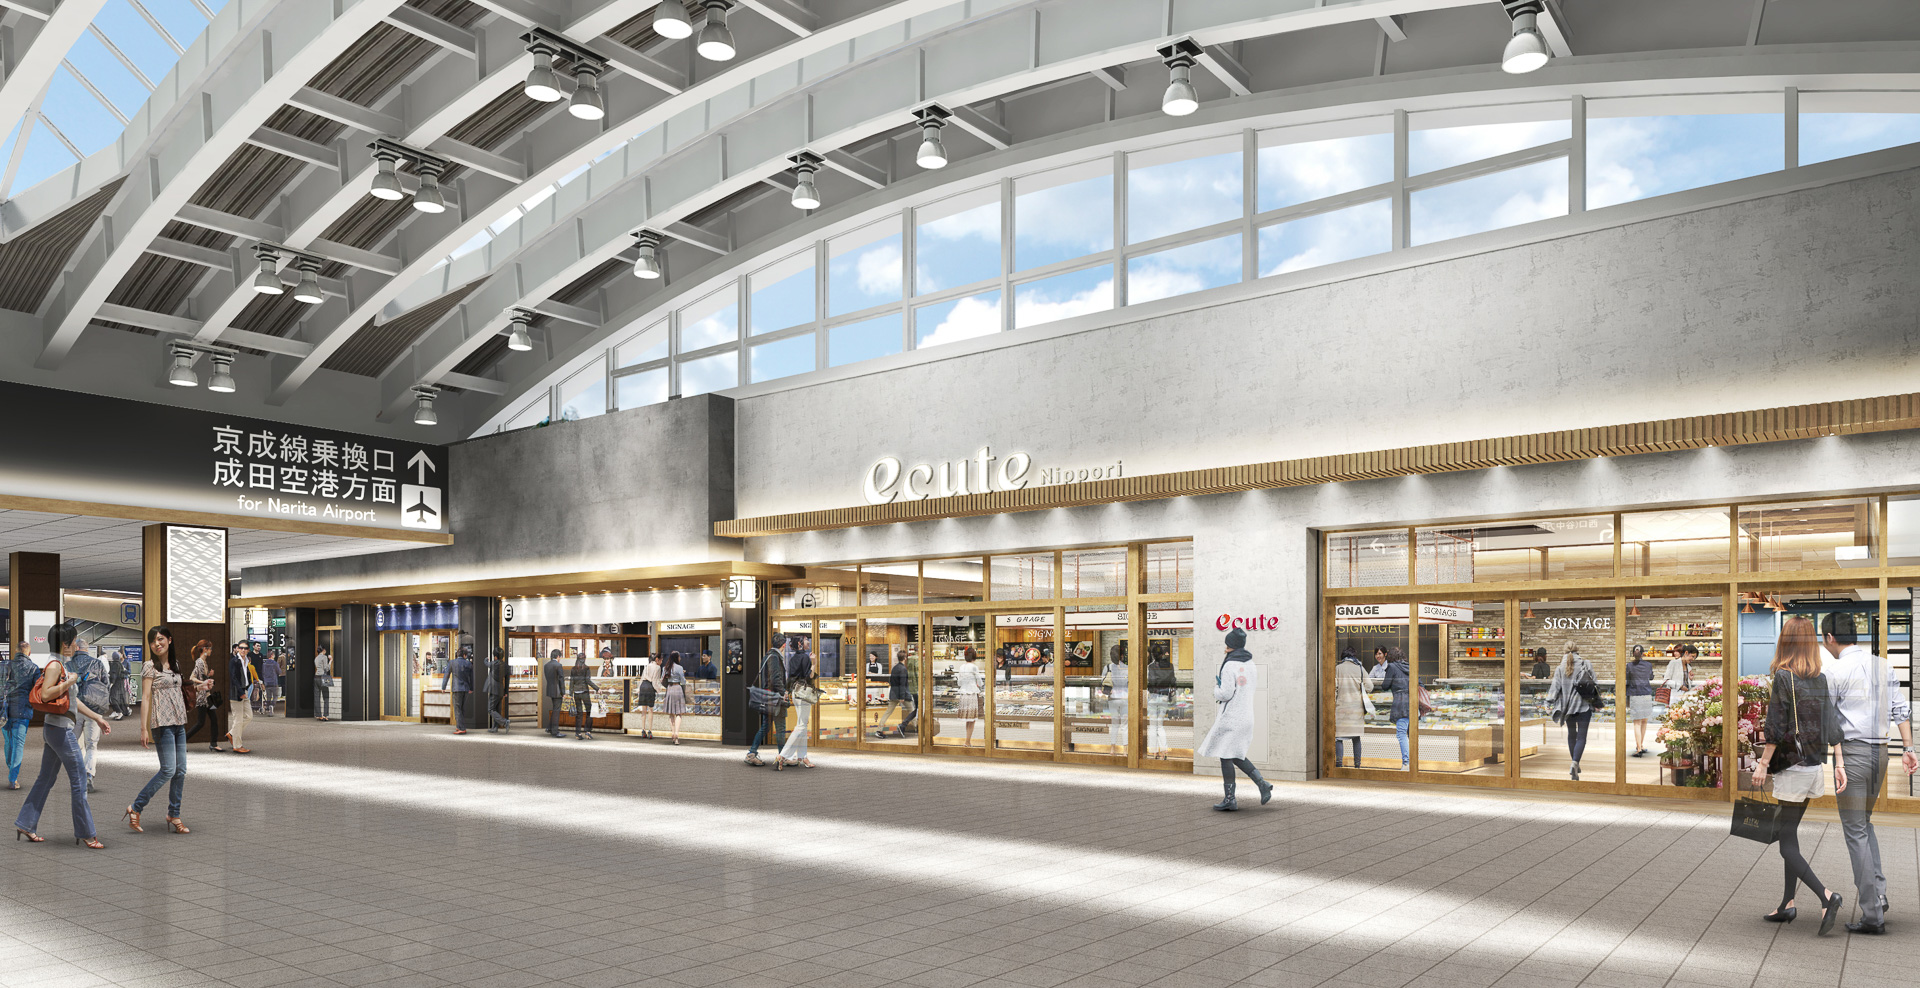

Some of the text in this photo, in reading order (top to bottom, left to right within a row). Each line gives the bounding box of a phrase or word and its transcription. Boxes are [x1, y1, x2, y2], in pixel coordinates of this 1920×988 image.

[212, 424, 394, 473] 京成線乗換口
[212, 457, 397, 504] 成田空港方面
[862, 445, 1123, 505] ecute Nippori
[237, 494, 377, 523] for Narita Airport
[1215, 613, 1280, 632] ecute
[1335, 606, 1380, 616] GNAGE
[1423, 606, 1457, 617] SIGNAGE
